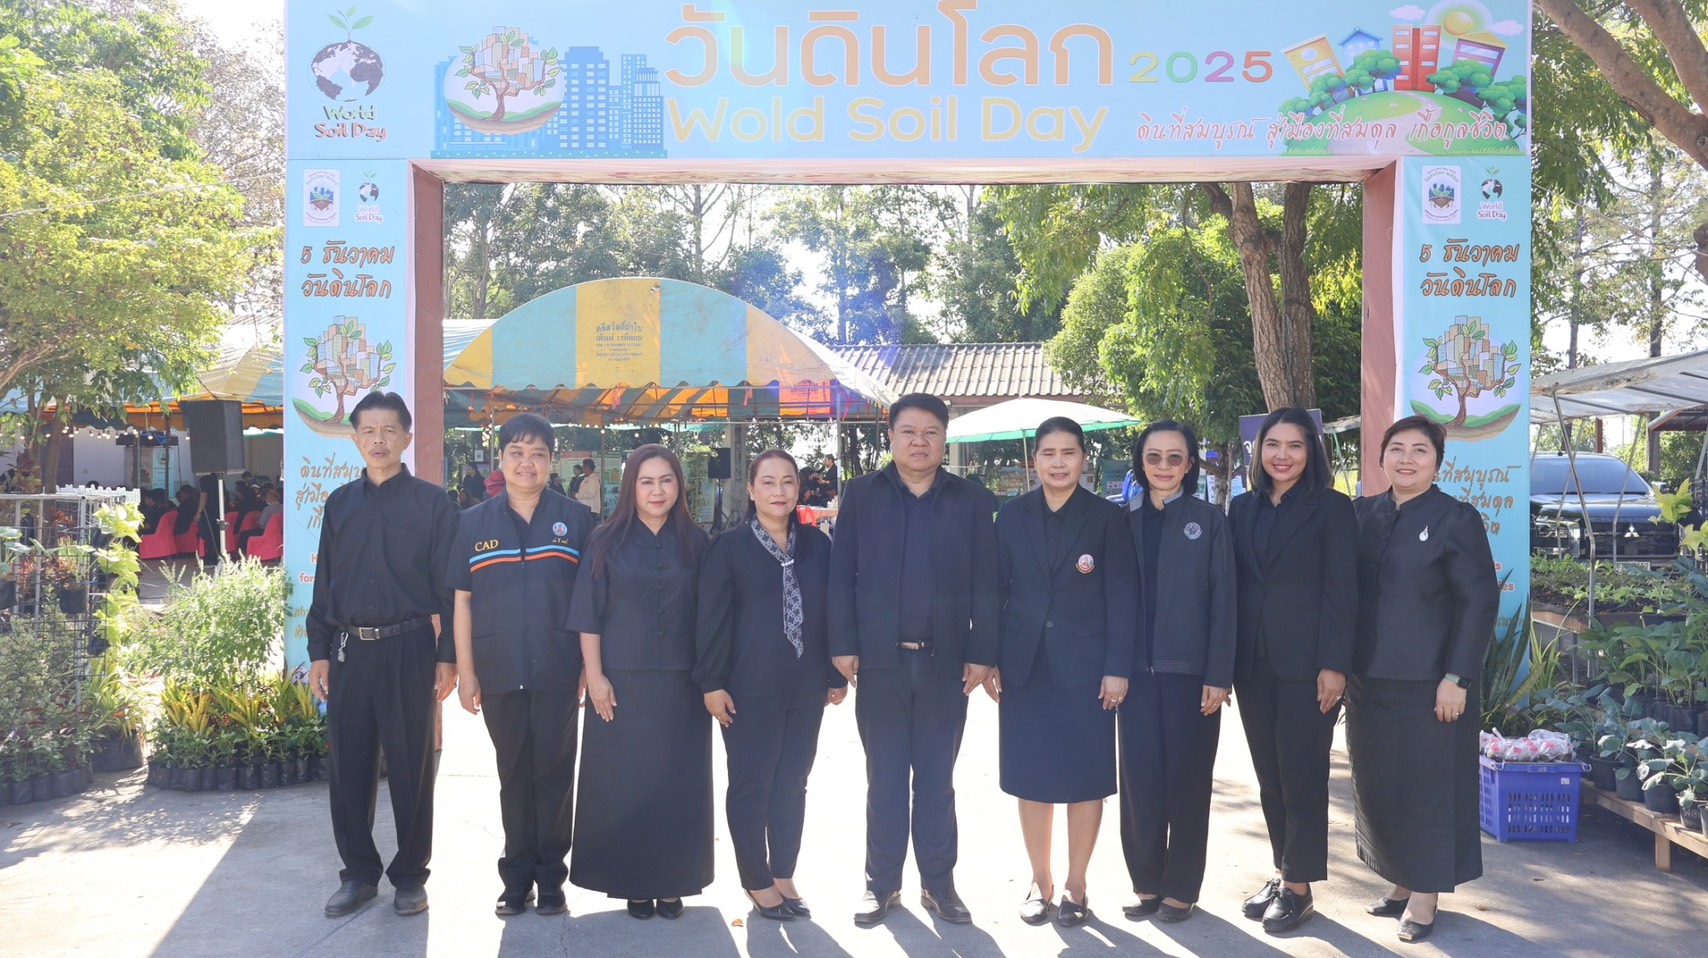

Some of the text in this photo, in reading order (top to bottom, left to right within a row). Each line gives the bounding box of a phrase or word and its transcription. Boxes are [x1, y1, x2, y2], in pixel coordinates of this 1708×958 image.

[664, 0, 1114, 87] วันดินโลก
[1127, 50, 1274, 83] 2025
[322, 104, 376, 120] World
[665, 95, 1109, 153] Wold Soil Day
[314, 121, 387, 142] Soil Day
[1136, 105, 1271, 150] ดินที่สมบูรณ์
[1408, 107, 1509, 149] เกื้อกูลชีวิต
[1478, 210, 1506, 219] Soil Day
[301, 240, 395, 269] 5 ธันวาคม
[1419, 238, 1520, 267] 5 ธันวาคม
[301, 267, 391, 298] วันดินโลก
[1420, 266, 1516, 298] วันดินโลก
[474, 539, 499, 552] CAD
